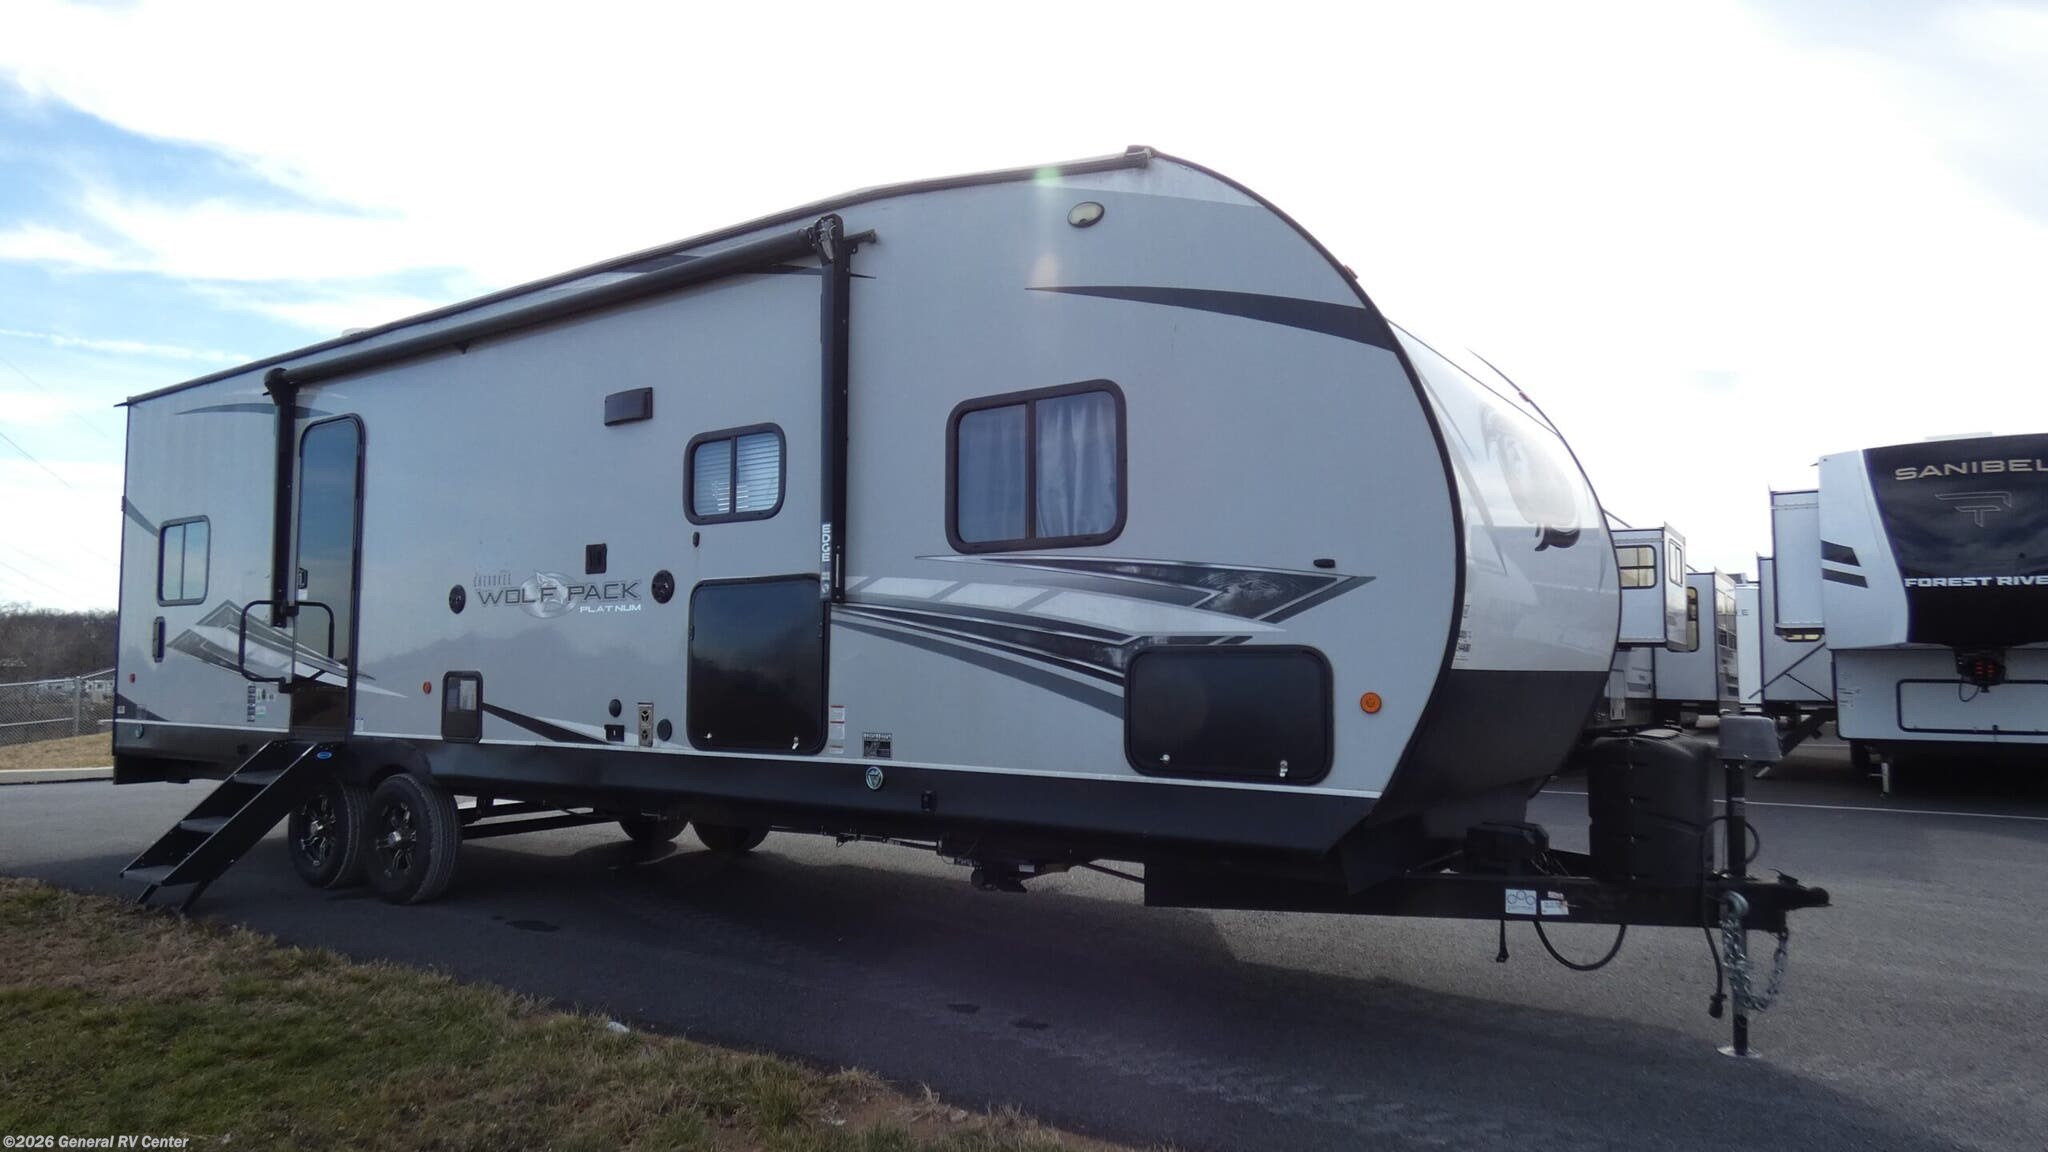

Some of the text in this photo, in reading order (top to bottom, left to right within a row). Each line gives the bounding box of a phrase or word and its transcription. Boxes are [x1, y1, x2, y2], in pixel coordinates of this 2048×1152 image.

[1895, 459, 2048, 481] SANIBEL
[822, 523, 832, 563] EDGE
[477, 581, 639, 605] WOLF PACK
[1903, 576, 1993, 588] FOREST
[580, 603, 642, 614] PLATNUM
